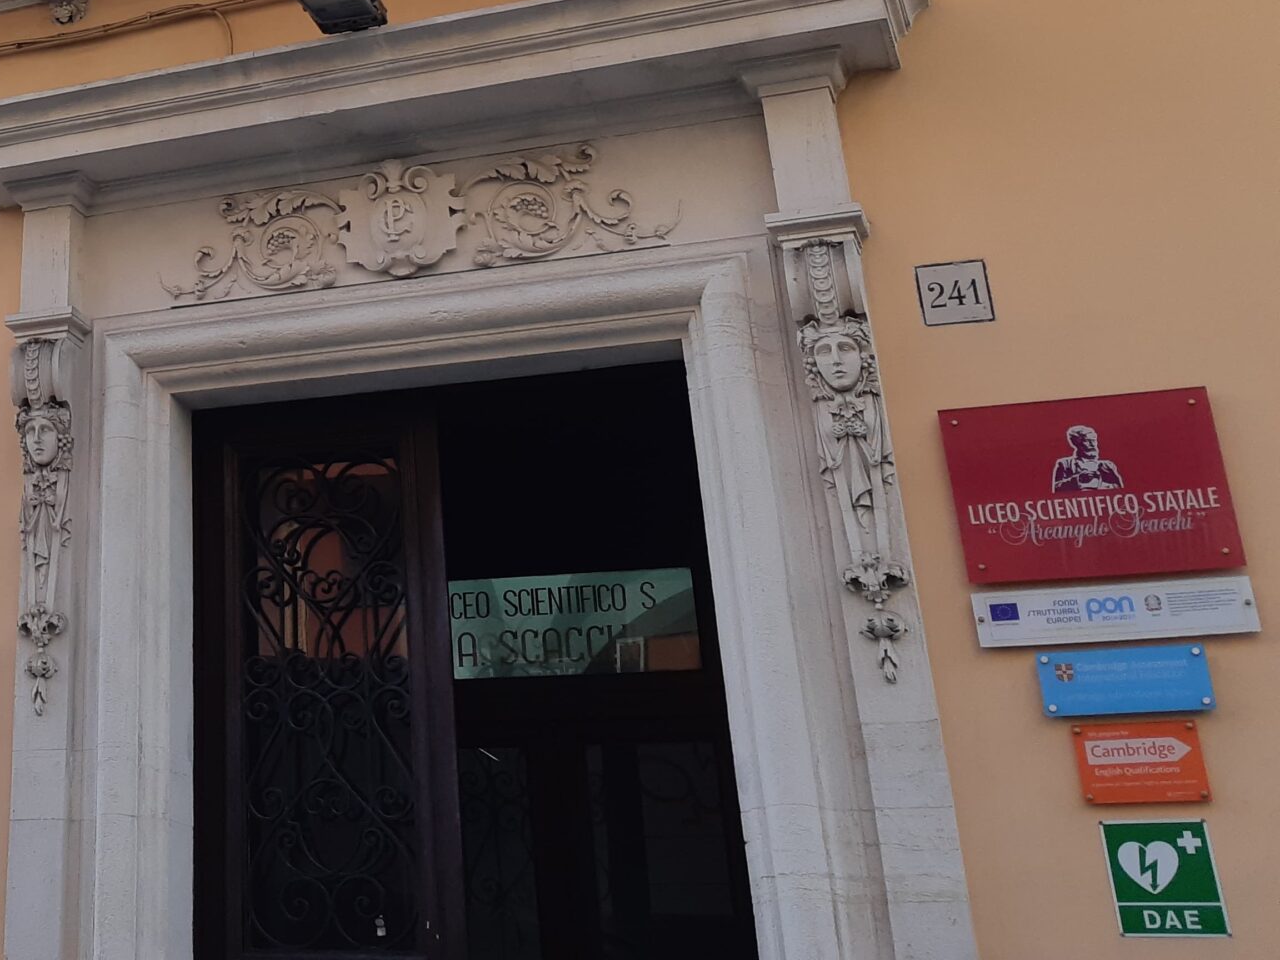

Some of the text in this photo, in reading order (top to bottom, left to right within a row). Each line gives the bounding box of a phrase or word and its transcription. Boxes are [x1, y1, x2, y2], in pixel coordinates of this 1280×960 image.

[926, 278, 983, 309] 241
[968, 486, 1221, 525] LICEO SCIENTIFICO STATALE
[450, 591, 490, 620] CEO
[503, 583, 627, 617] SCIENTIFICO
[1086, 596, 1135, 622] pon
[498, 624, 625, 665] SCACC
[1091, 741, 1176, 759] Cambridge
[1094, 765, 1181, 777] English Qualifications
[1142, 909, 1203, 930] DAE
